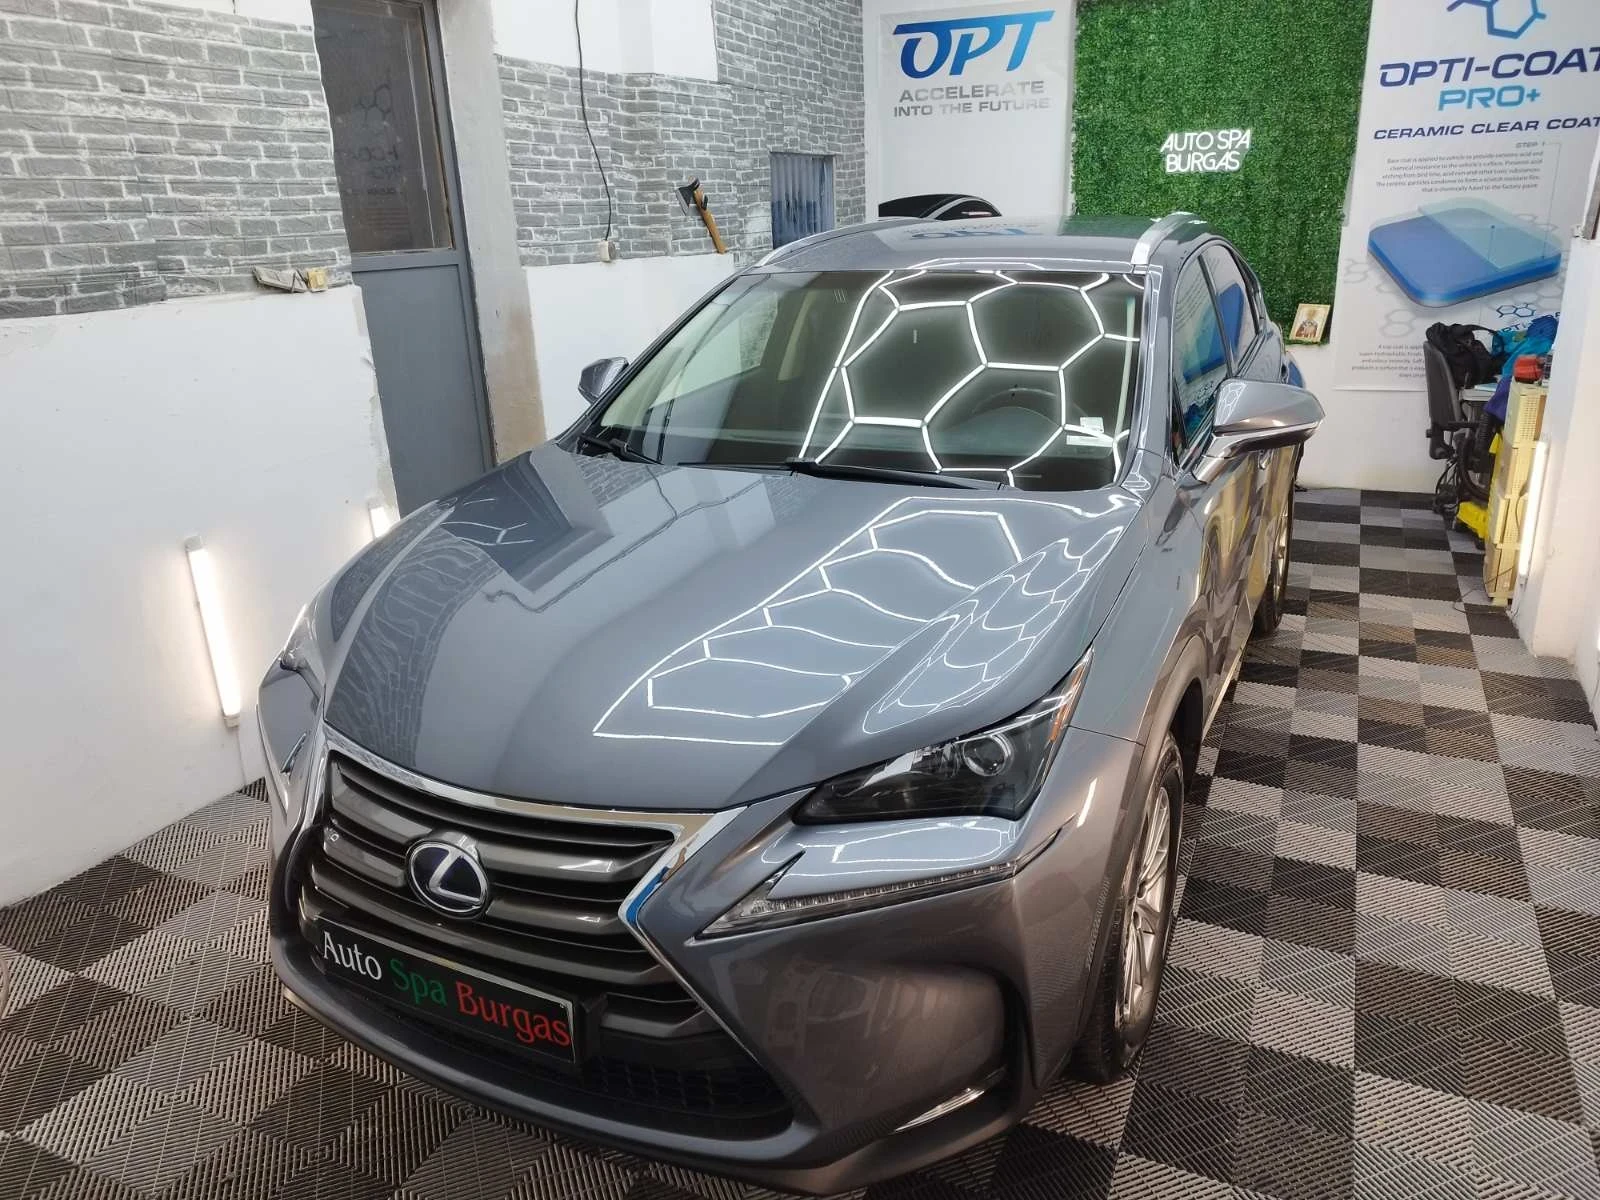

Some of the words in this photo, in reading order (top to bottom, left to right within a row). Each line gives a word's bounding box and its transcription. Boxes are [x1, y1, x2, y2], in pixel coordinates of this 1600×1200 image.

[893, 10, 1055, 79] OPT
[898, 80, 1045, 103] ACCELERATE
[1438, 85, 1540, 111] PRO+
[893, 100, 933, 117] INTO
[940, 100, 975, 116] THE
[978, 97, 1051, 114] FUTURE
[1373, 124, 1465, 140] CERAMIC
[1471, 120, 1540, 135] CLEAR
[1546, 116, 1600, 130] COAT
[1160, 131, 1214, 153] AUTO
[1216, 128, 1252, 150] SPA
[1165, 151, 1241, 173] BURGAS
[322, 931, 383, 981] Auto
[389, 959, 448, 1007] Spa
[455, 981, 572, 1047] Burgas
